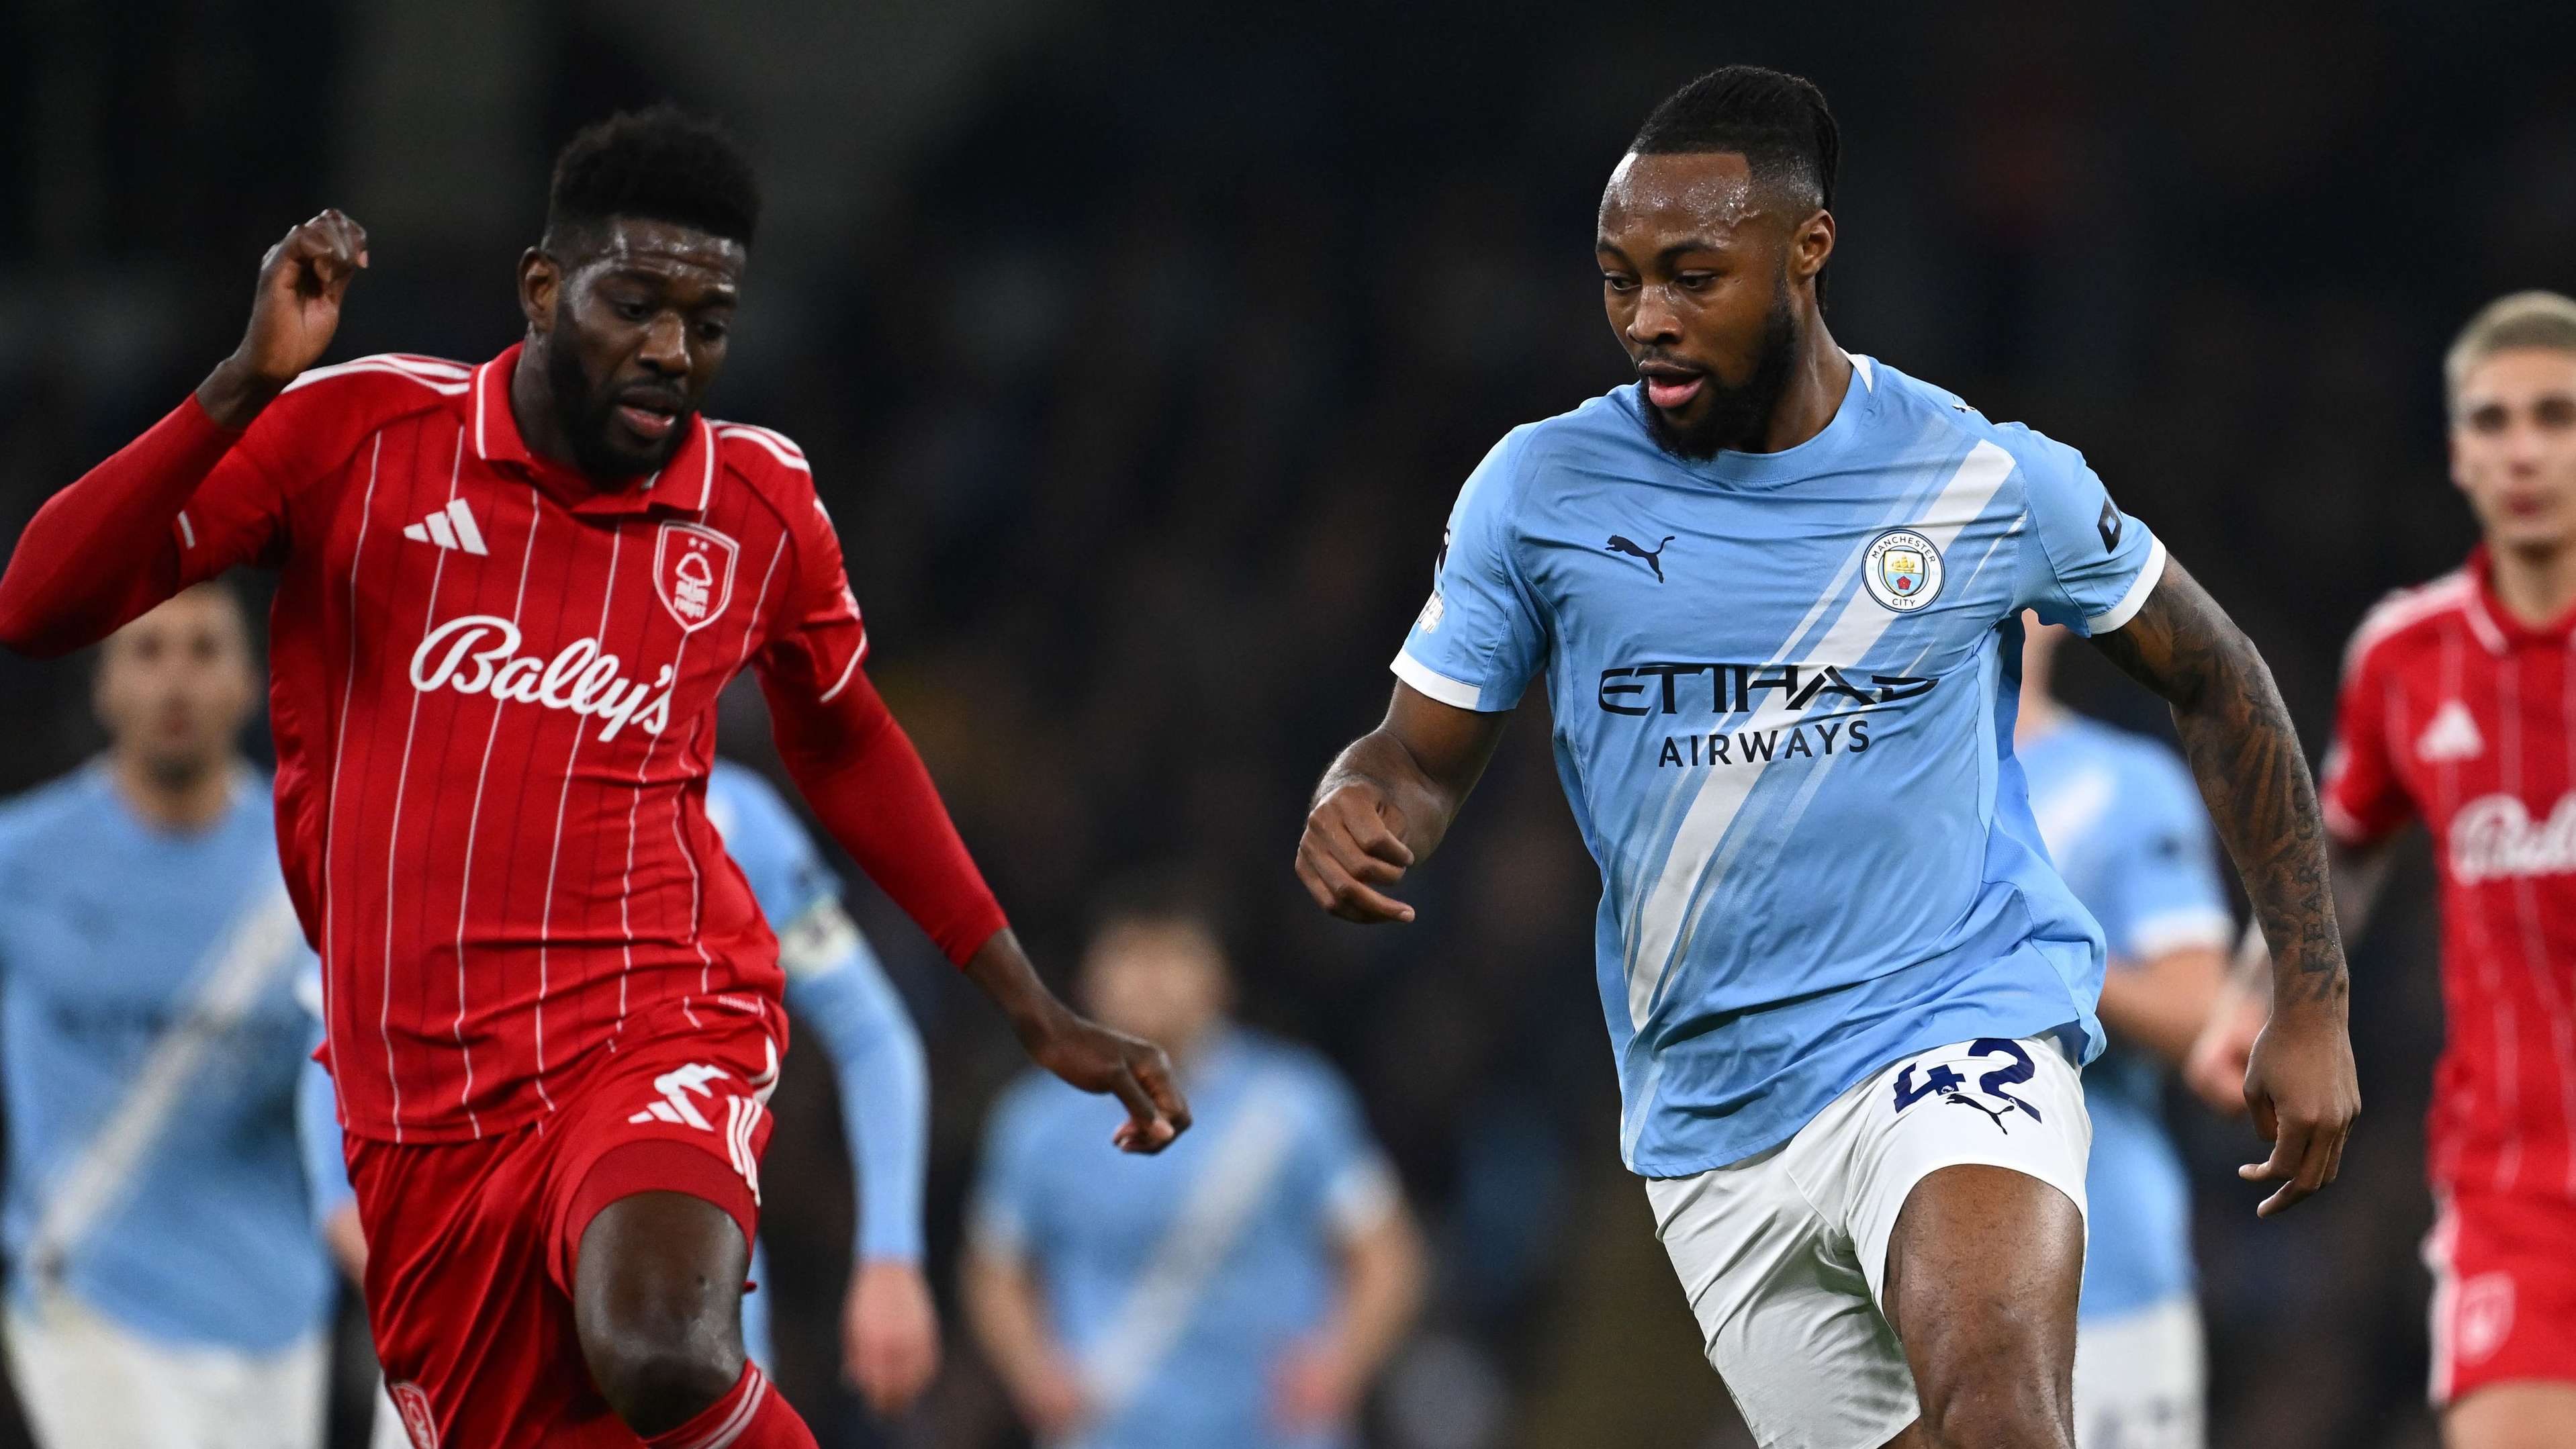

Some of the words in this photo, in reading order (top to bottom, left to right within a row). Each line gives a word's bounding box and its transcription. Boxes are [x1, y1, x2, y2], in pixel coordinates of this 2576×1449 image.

[1872, 535, 1936, 563] MANCHESTER
[1892, 598, 1916, 607] CITY
[410, 614, 673, 742] Bally's
[1598, 664, 1940, 716] ETIHAD
[1659, 720, 1870, 767] AIRWAYS
[1892, 1037, 2042, 1124] 42
